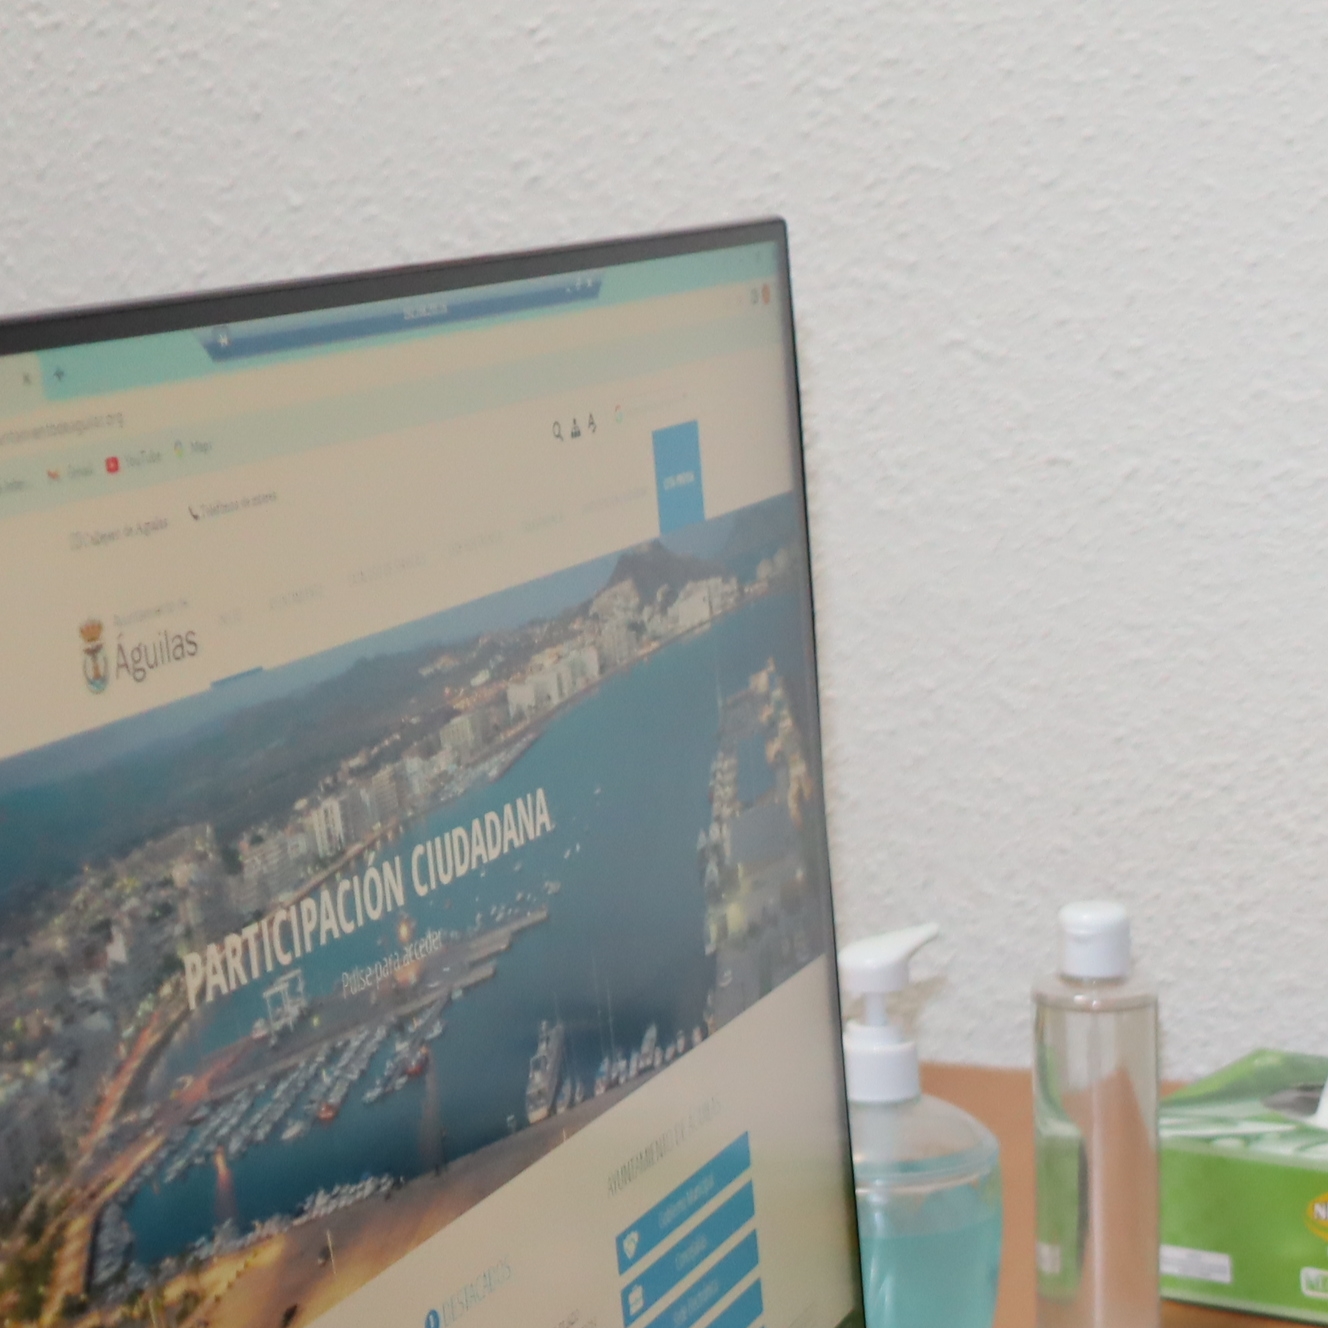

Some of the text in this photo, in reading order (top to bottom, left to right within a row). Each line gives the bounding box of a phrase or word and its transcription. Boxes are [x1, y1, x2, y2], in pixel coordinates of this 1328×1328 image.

[115, 630, 199, 683] Águilas
[182, 787, 554, 1010] PARTICIPACIÓN CIUDADANA
[341, 965, 373, 998] Pulse
[374, 951, 400, 990] para
